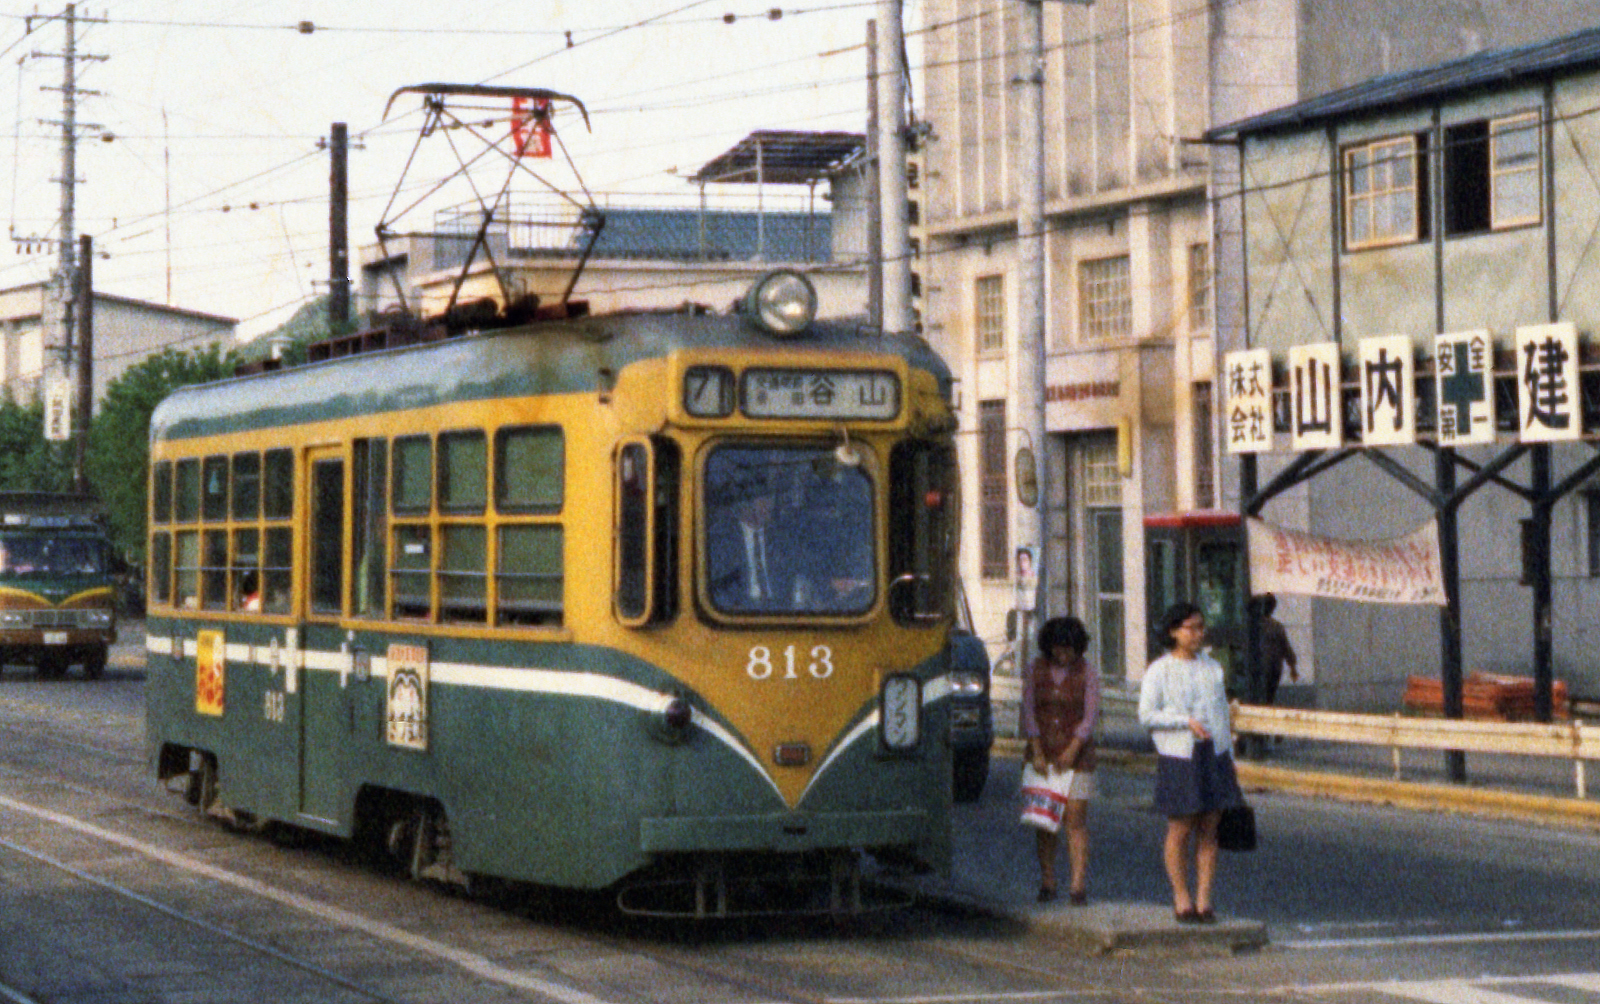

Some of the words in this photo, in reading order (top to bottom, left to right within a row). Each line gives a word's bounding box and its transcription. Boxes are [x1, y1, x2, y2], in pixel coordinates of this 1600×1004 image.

[1437, 335, 1486, 373] 安全
[1229, 361, 1265, 398] 株式
[1230, 404, 1267, 444] 会社
[1440, 406, 1489, 441] 第一
[746, 644, 834, 680] 813
